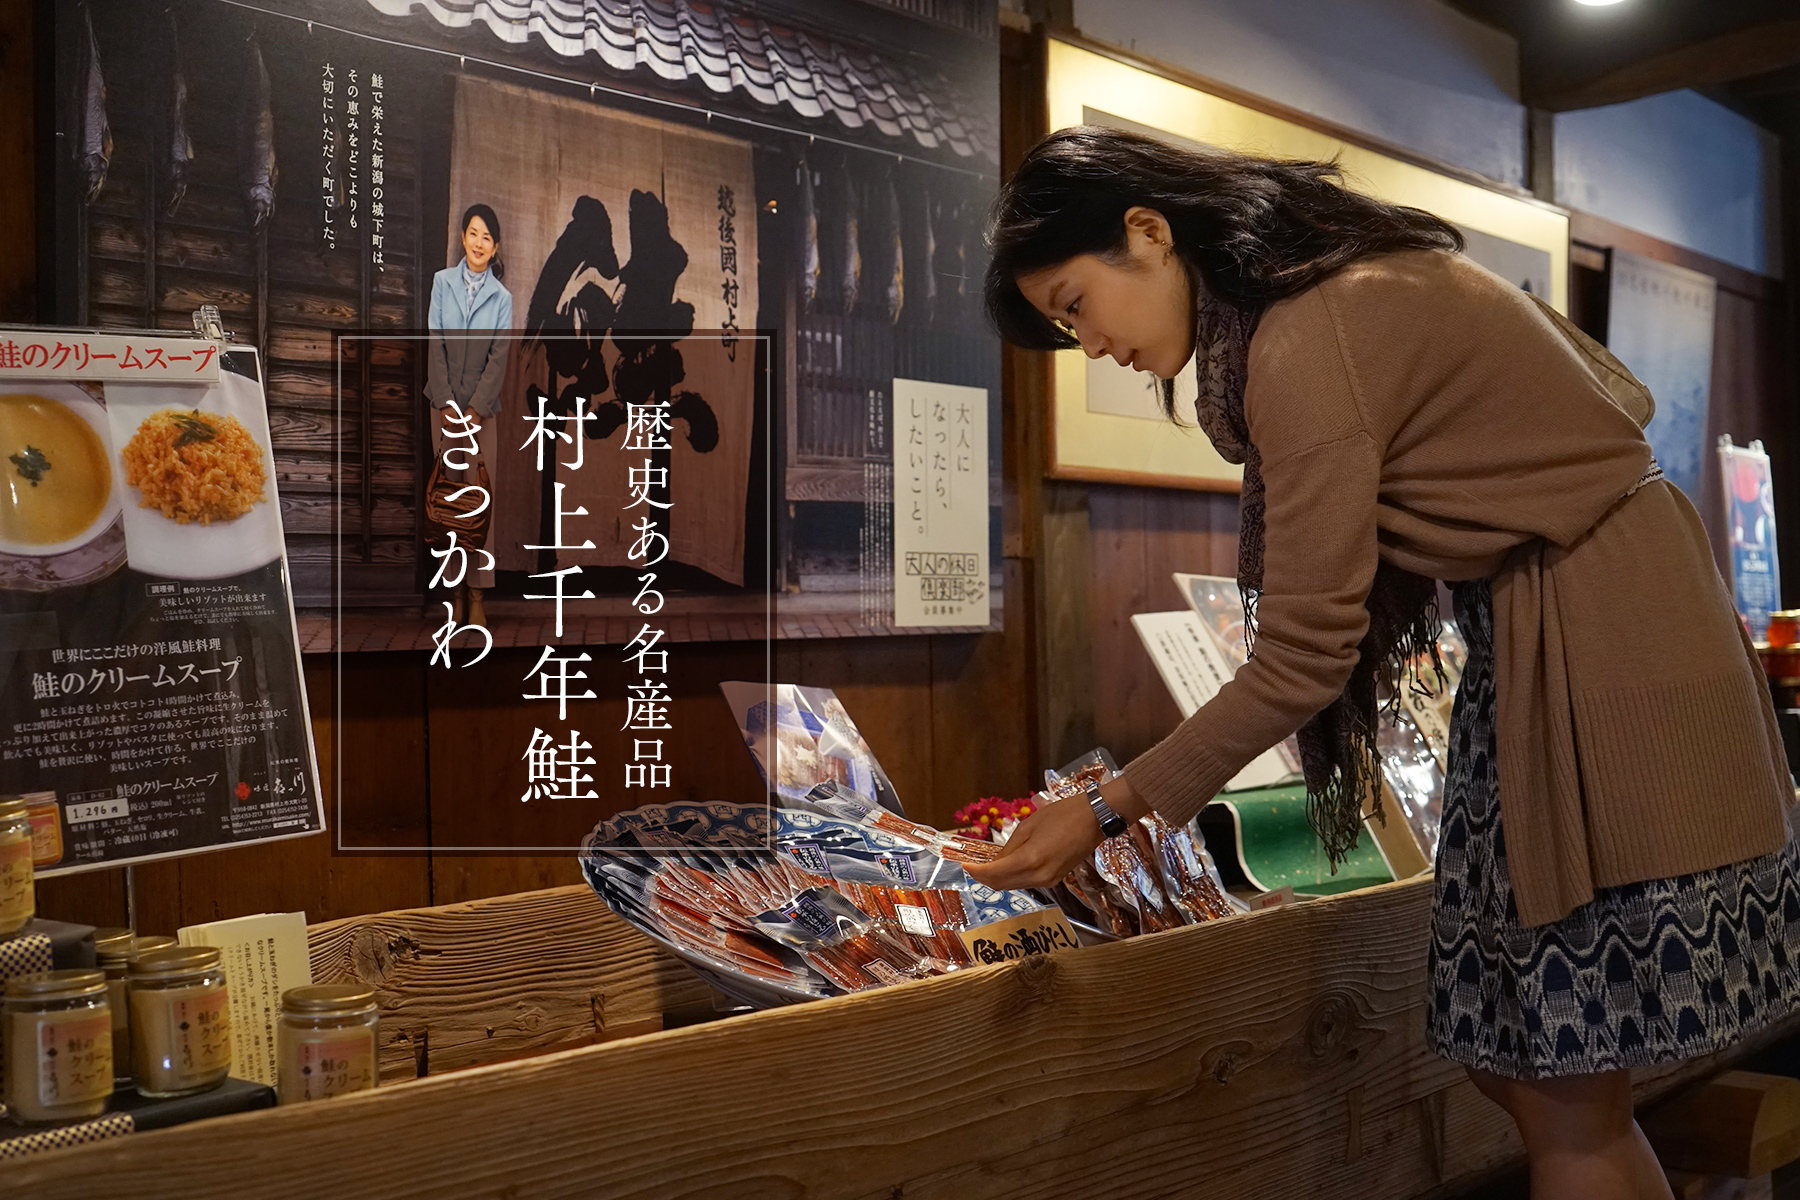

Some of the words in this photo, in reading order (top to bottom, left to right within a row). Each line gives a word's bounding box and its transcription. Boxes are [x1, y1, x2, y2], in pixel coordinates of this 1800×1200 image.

[322, 63, 335, 250] 大切にいただく町でした。
[347, 69, 359, 229] その恵みをどこよりも
[371, 73, 384, 272] 鮭で栄えた新潟の城下町は、
[909, 398, 924, 534] したいこと。
[933, 401, 947, 509] なったら、
[956, 403, 971, 472] 大人に
[31, 655, 243, 700] 鮭のクリームスープ
[52, 637, 221, 664] 世界にここだけの洋風鮭料理
[0, 708, 288, 747] っぷり加えて出来上がった濃厚でコクのあるスープです。そのまま温めて
[116, 771, 219, 799] 鮭のクリームスープ
